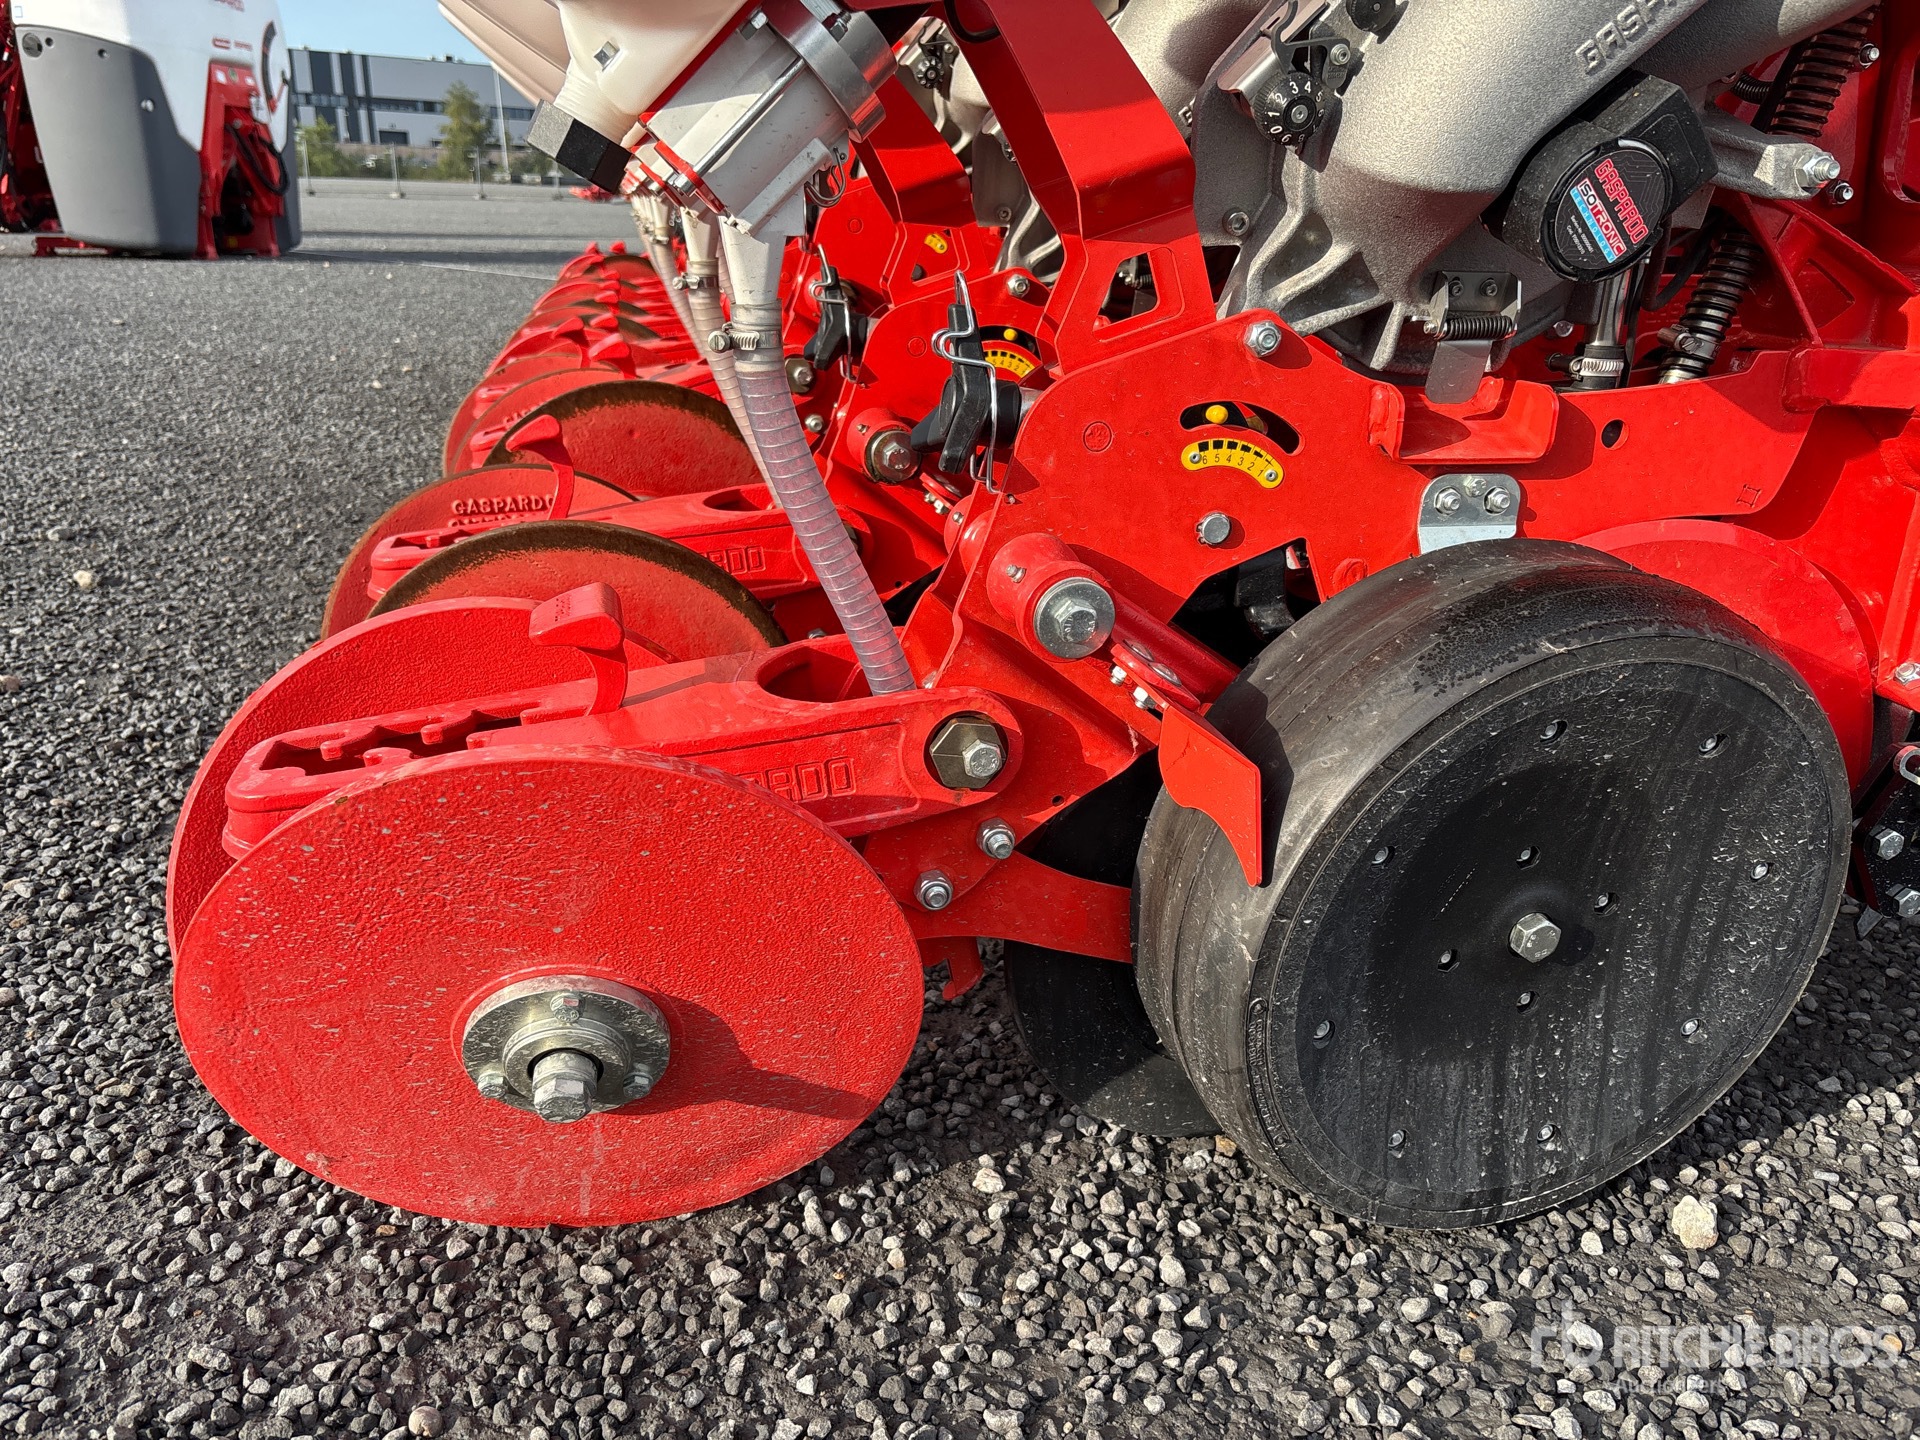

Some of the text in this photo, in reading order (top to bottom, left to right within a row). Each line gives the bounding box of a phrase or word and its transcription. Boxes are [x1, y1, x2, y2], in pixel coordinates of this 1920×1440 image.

[1575, 0, 1677, 75] GASP
[1289, 81, 1299, 94] 3
[1304, 80, 1312, 94] 4
[1274, 92, 1288, 105] 2
[1315, 89, 1324, 102] 5
[1270, 125, 1283, 134] 0
[1594, 158, 1649, 244] GASPARDO
[1571, 188, 1617, 261] TECHNOLOGY
[1580, 180, 1627, 256] ISOTRONIC
[1202, 455, 1208, 465] 6
[1214, 453, 1220, 463] 5
[1226, 454, 1232, 464] 4
[1237, 456, 1245, 467] 3
[1247, 461, 1256, 472] 2
